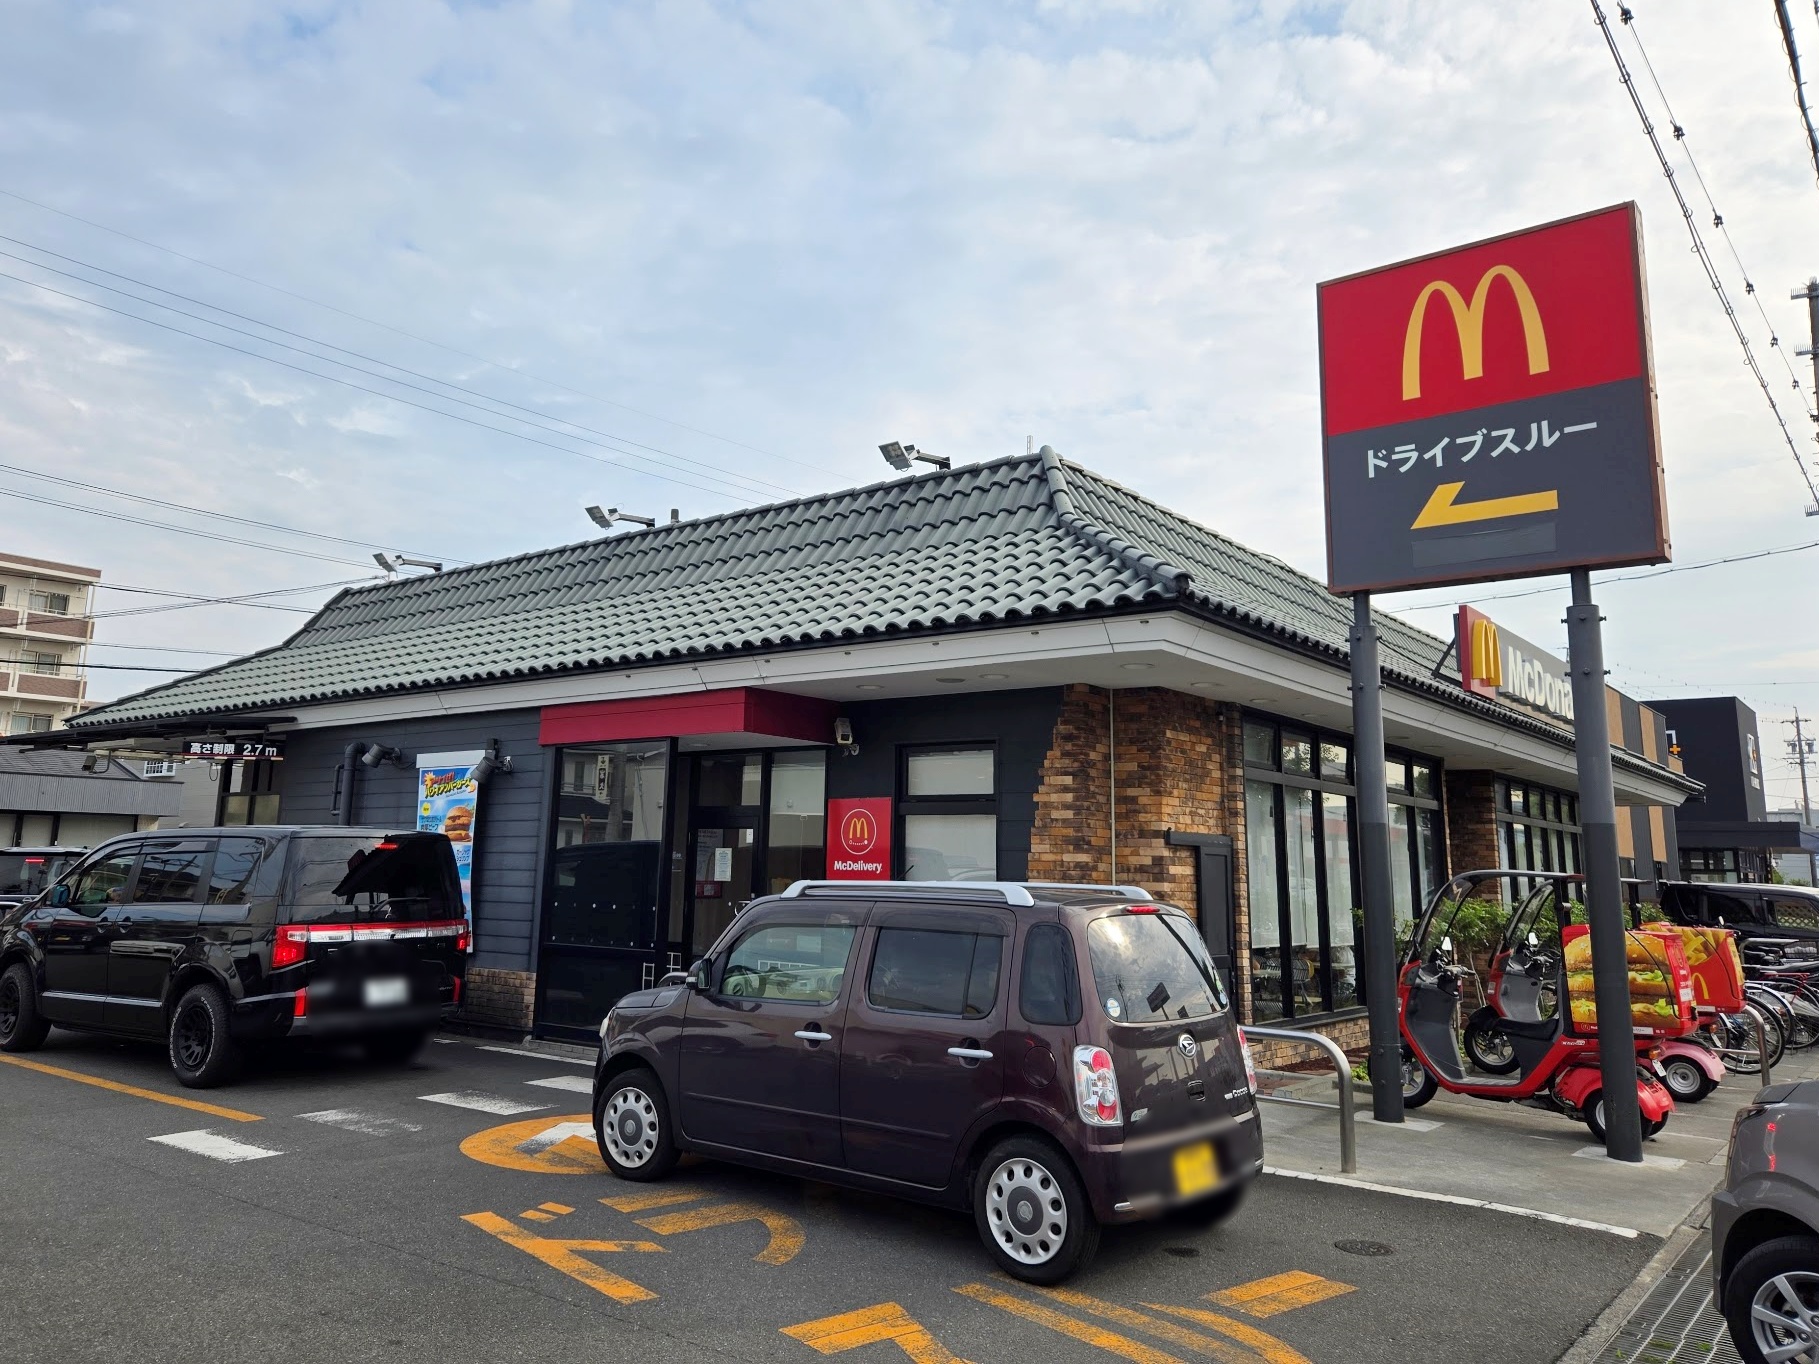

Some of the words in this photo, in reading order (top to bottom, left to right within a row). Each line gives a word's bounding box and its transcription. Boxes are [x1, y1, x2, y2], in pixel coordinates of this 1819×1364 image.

[1367, 420, 1598, 478] ドライブスルー
[190, 742, 235, 754] 高さ制限
[243, 744, 263, 756] 2.7
[265, 747, 277, 756] m
[833, 860, 883, 874] McDelivery
